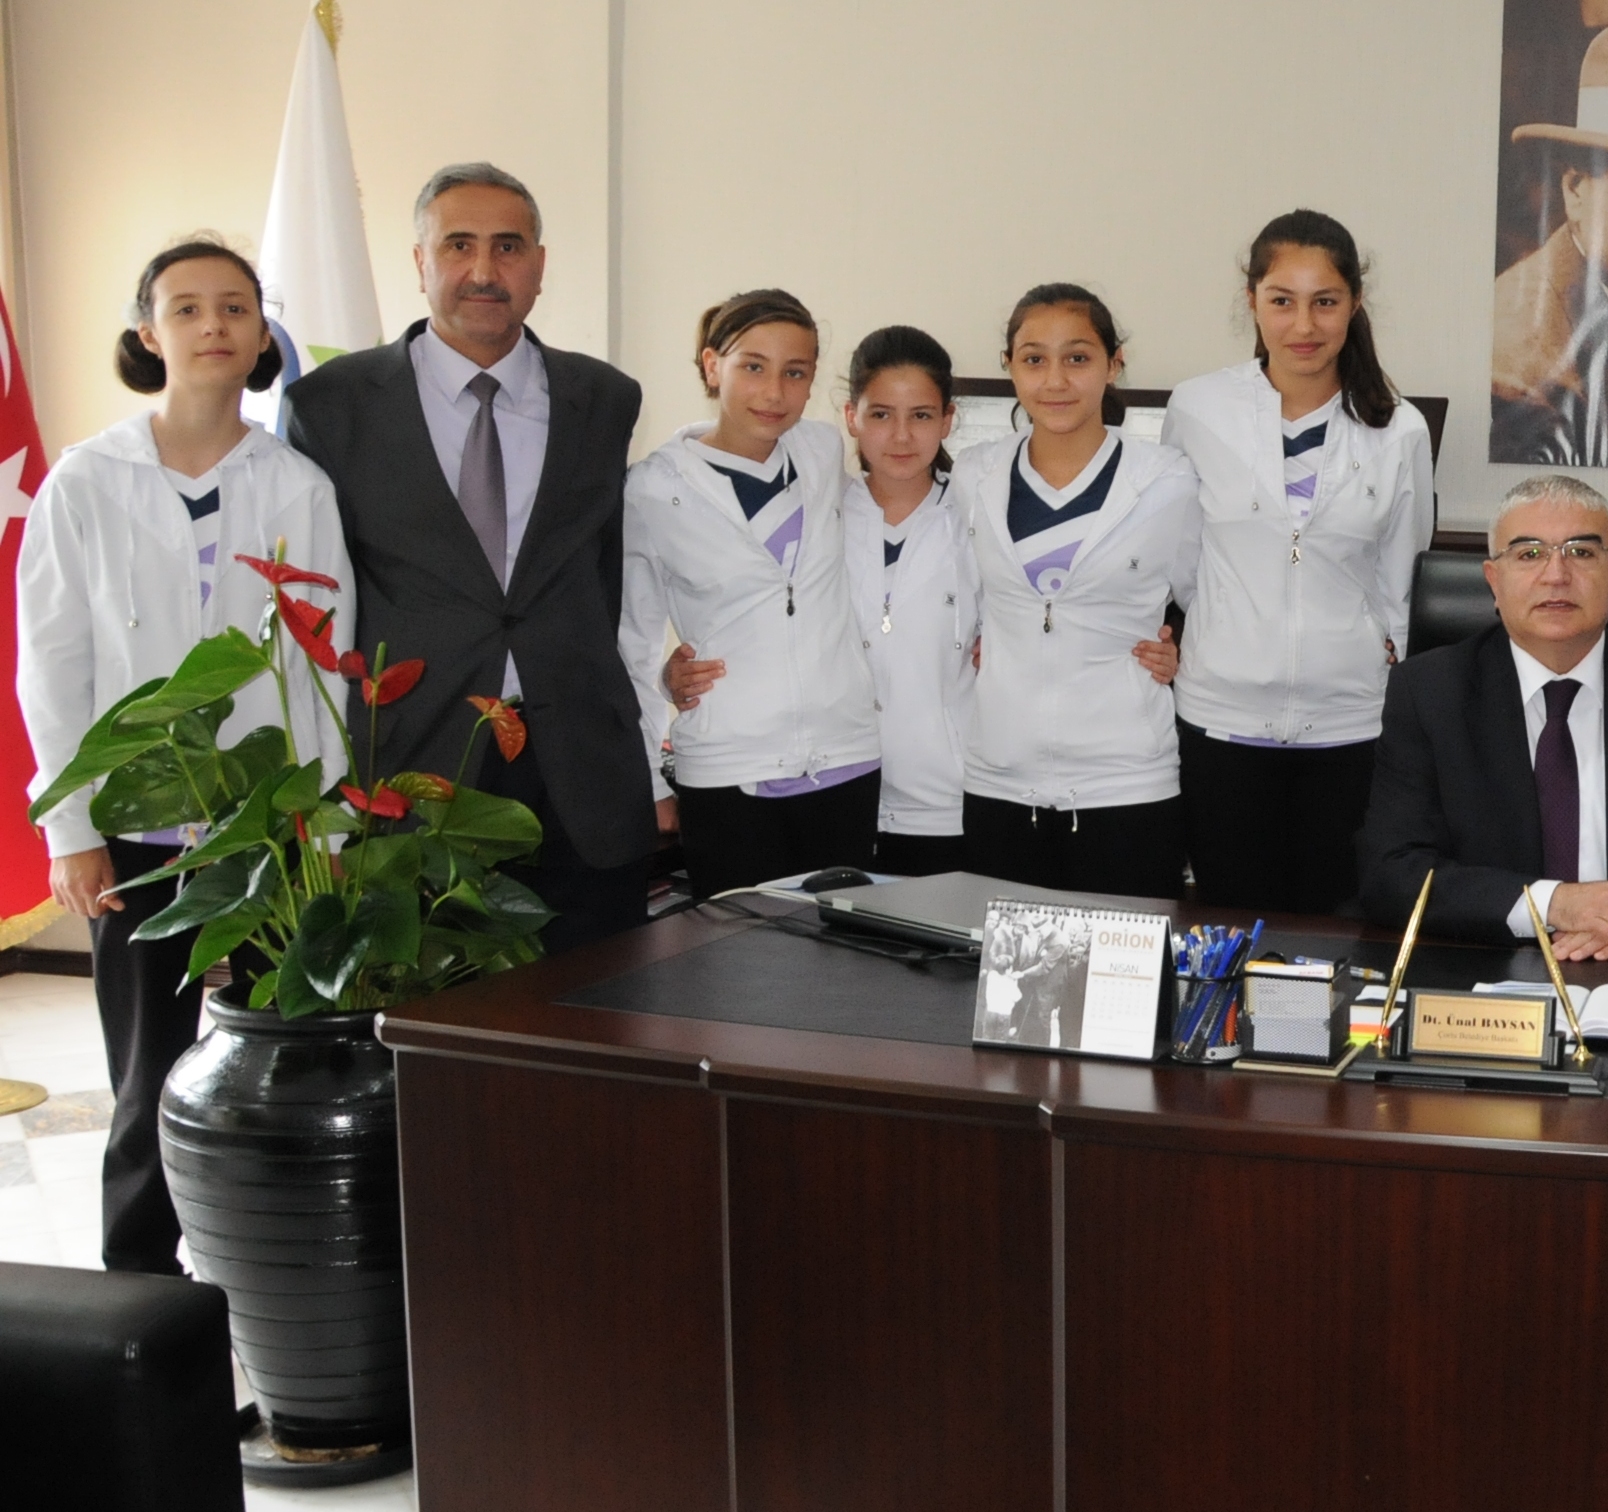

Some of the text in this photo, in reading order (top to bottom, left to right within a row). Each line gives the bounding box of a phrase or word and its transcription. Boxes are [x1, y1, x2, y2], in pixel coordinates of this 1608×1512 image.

[1422, 1013, 1536, 1030] Dt. Ünal BAYSAN
